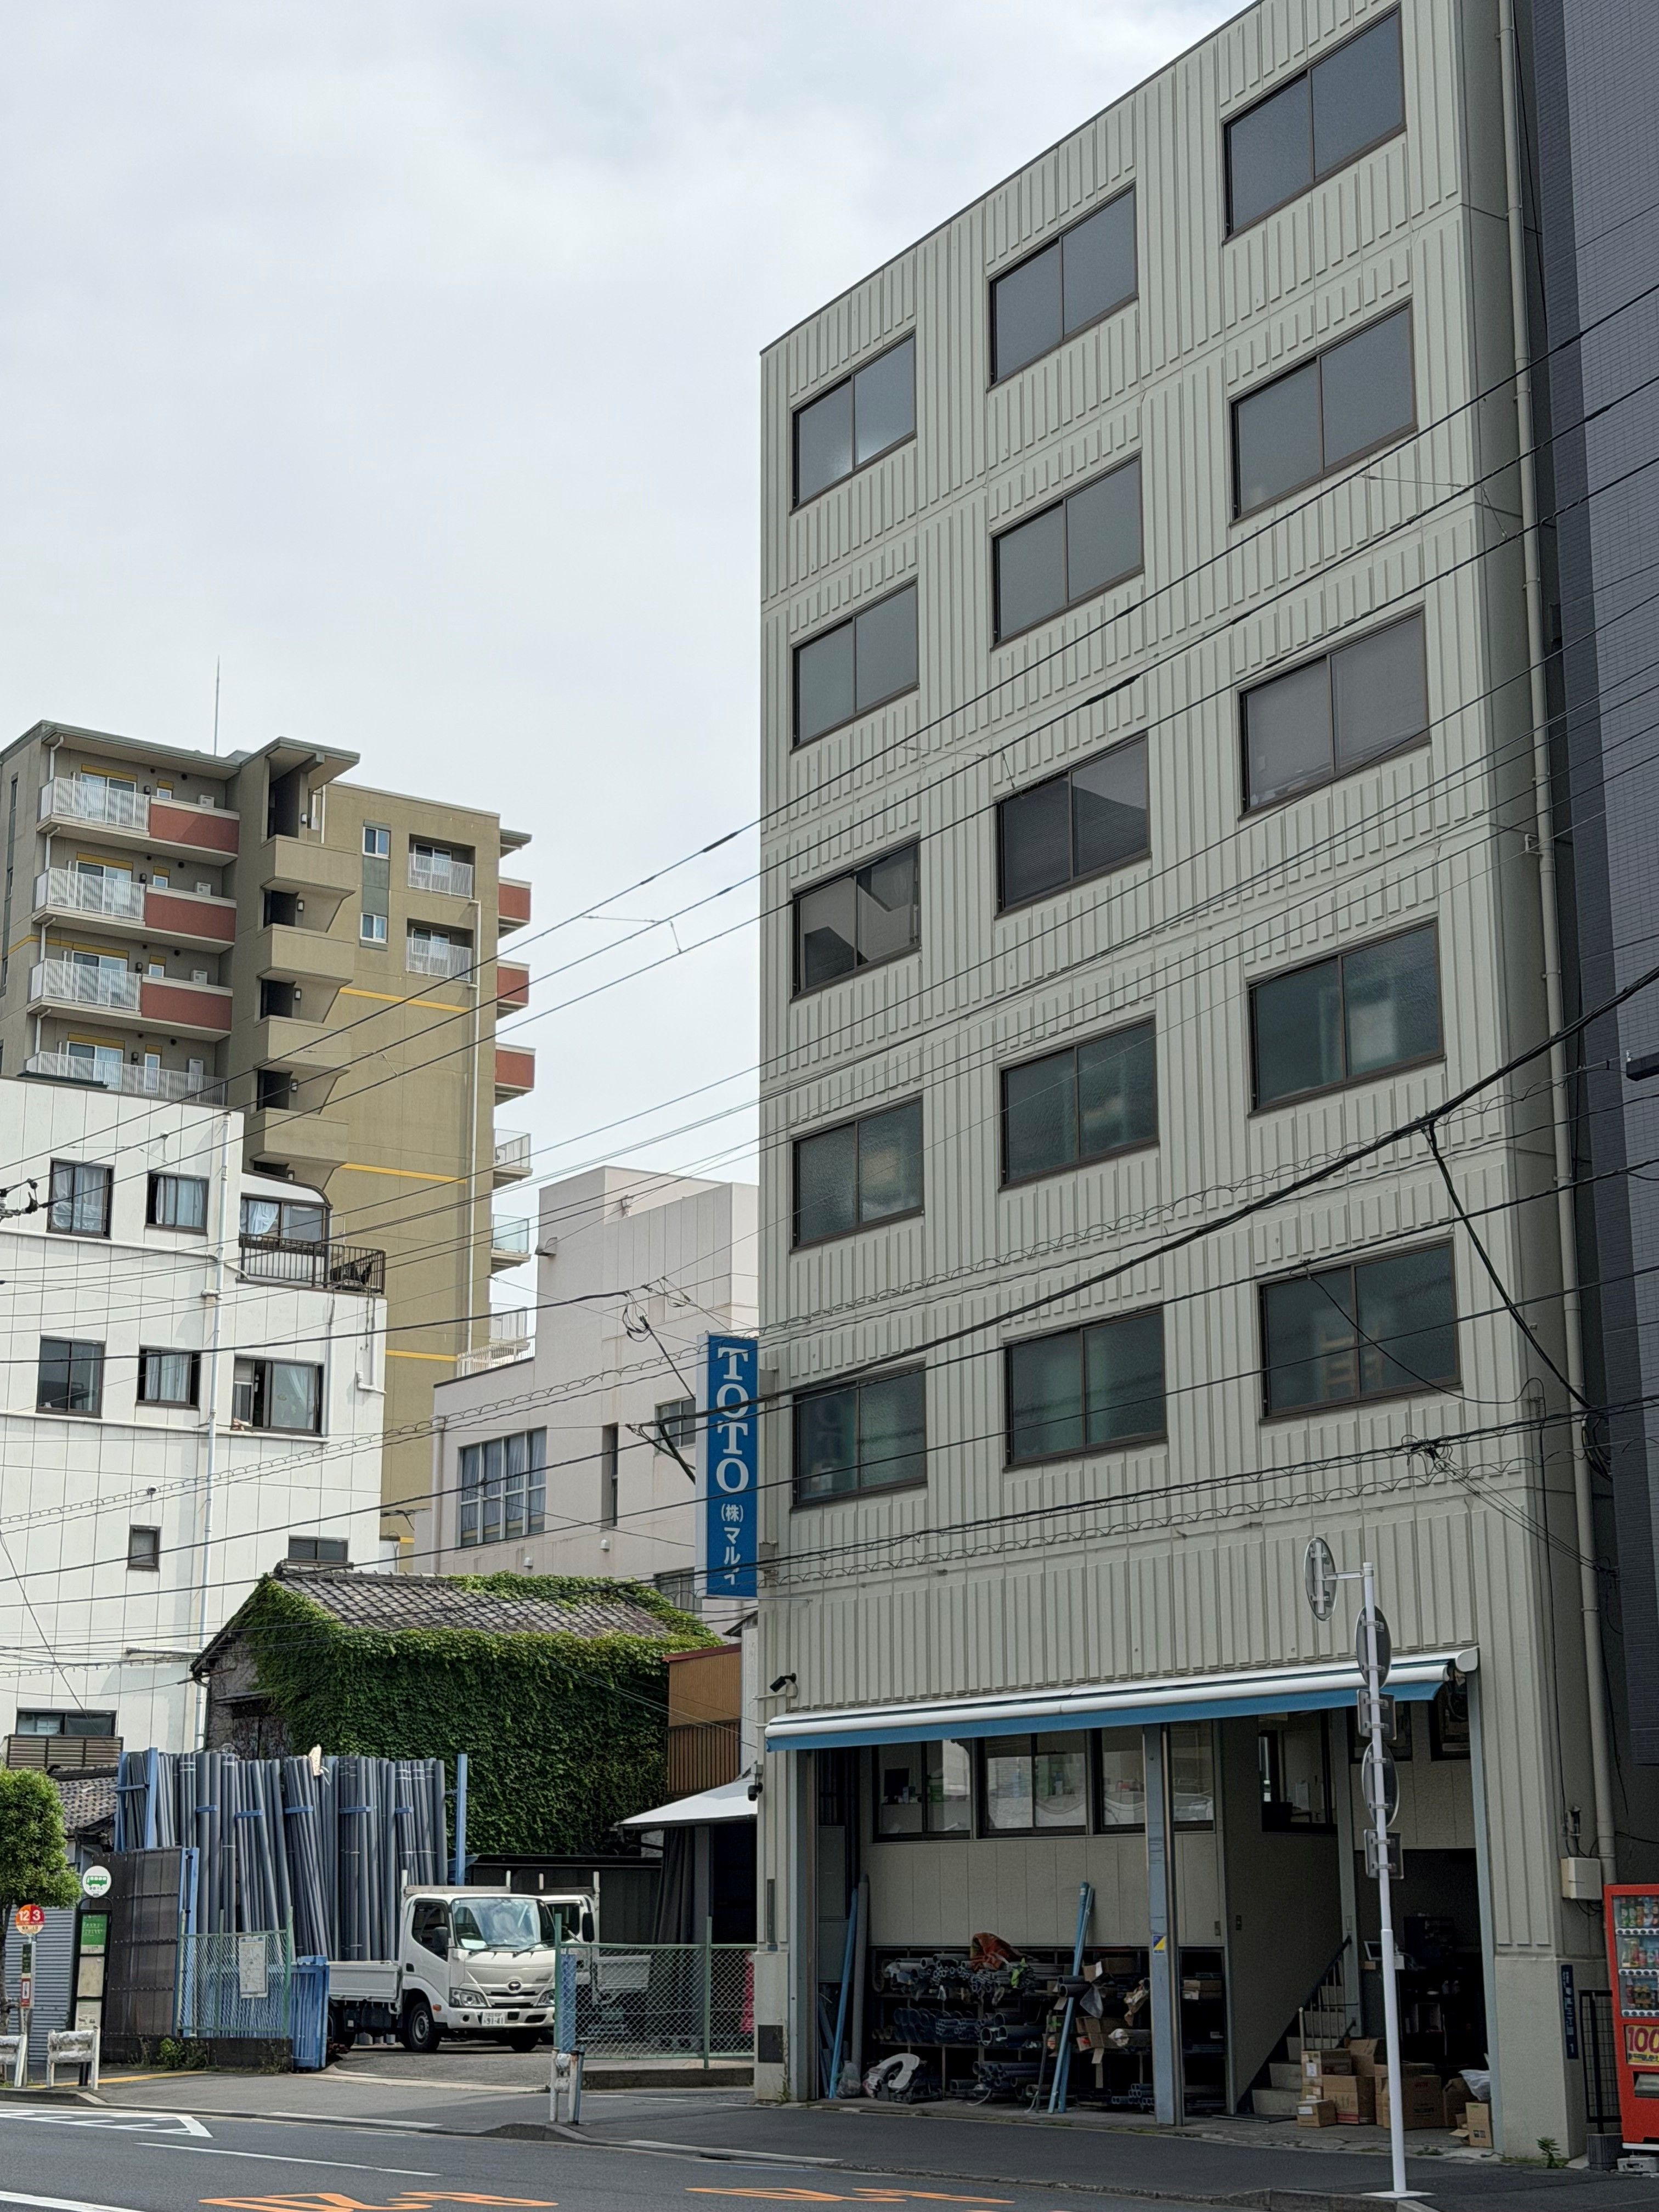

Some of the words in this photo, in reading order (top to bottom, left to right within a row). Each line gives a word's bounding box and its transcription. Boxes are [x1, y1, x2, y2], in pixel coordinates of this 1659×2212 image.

[716, 1347, 749, 1493] TOTO
[19, 1910, 30, 1921] 12
[32, 1909, 41, 1921] 3
[1628, 2027, 1659, 2053] 100
